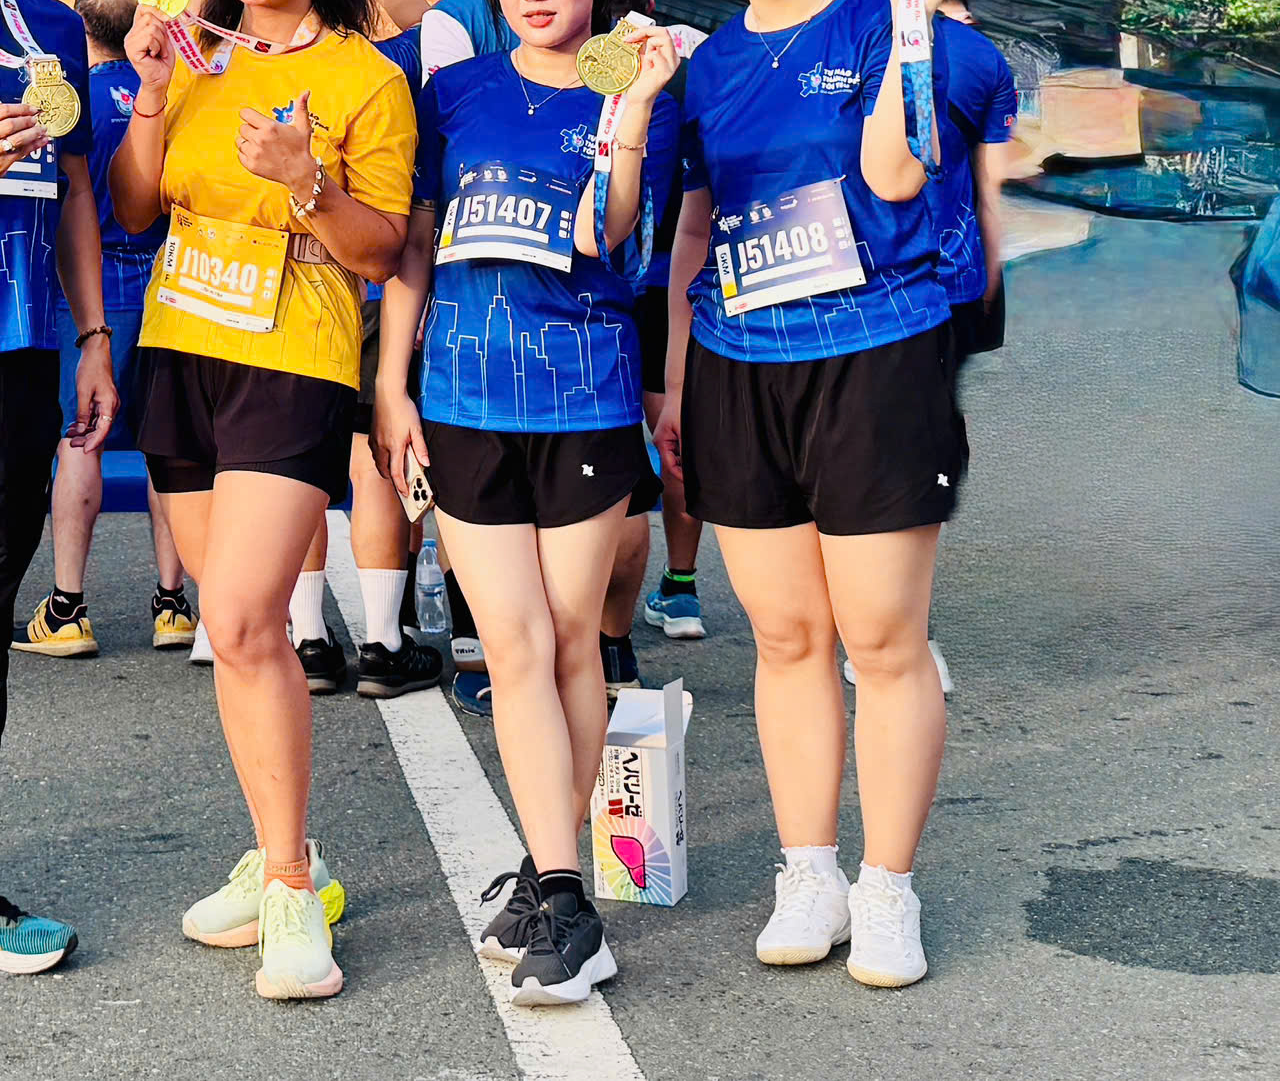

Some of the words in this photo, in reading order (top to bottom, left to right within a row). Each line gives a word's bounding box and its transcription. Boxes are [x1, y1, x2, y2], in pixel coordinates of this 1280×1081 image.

[459, 194, 552, 231] J51407
[167, 241, 177, 268] 10KM
[737, 222, 829, 274] J51408
[180, 246, 259, 294] J10340
